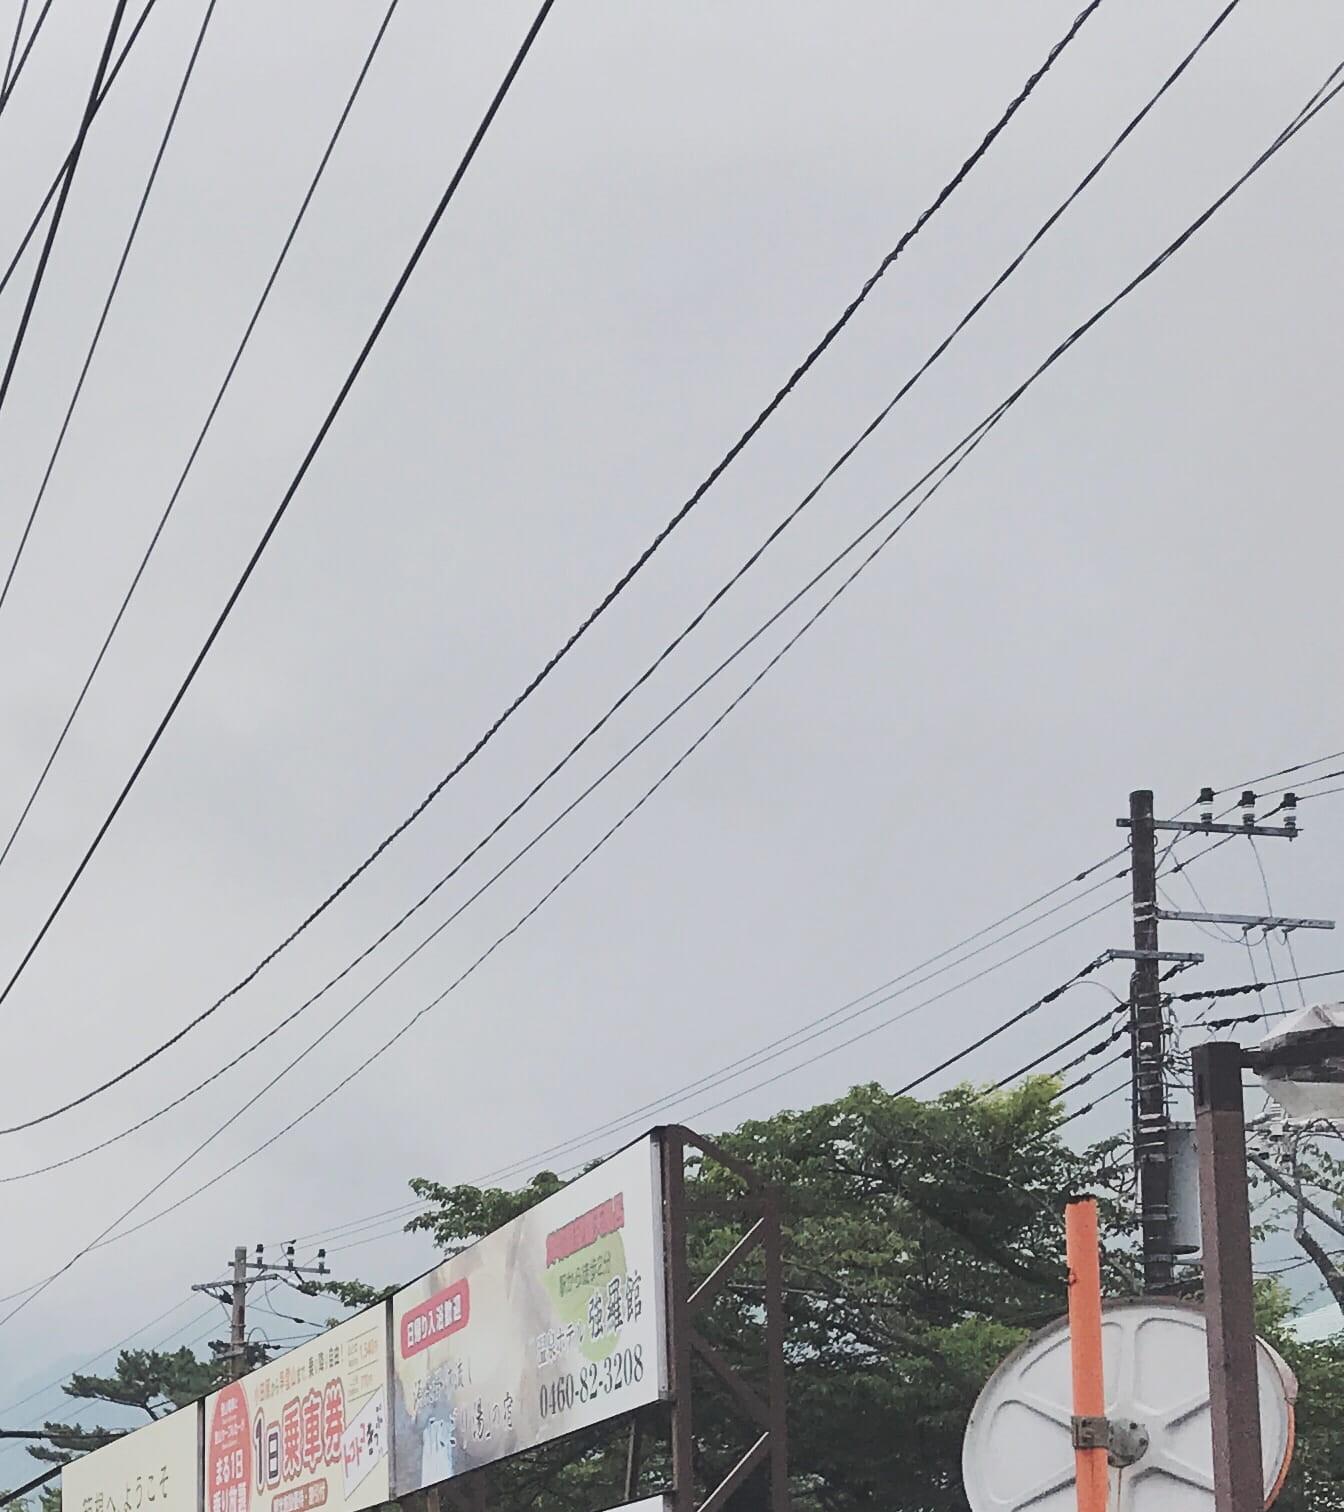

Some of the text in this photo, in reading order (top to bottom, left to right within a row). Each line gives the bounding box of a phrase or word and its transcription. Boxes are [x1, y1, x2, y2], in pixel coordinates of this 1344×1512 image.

[588, 1269, 643, 1340] 強羅館
[540, 1343, 644, 1420] 0460-82-3208
[215, 1449, 243, 1486] まる1日
[254, 1377, 346, 1496] 1日乗車券
